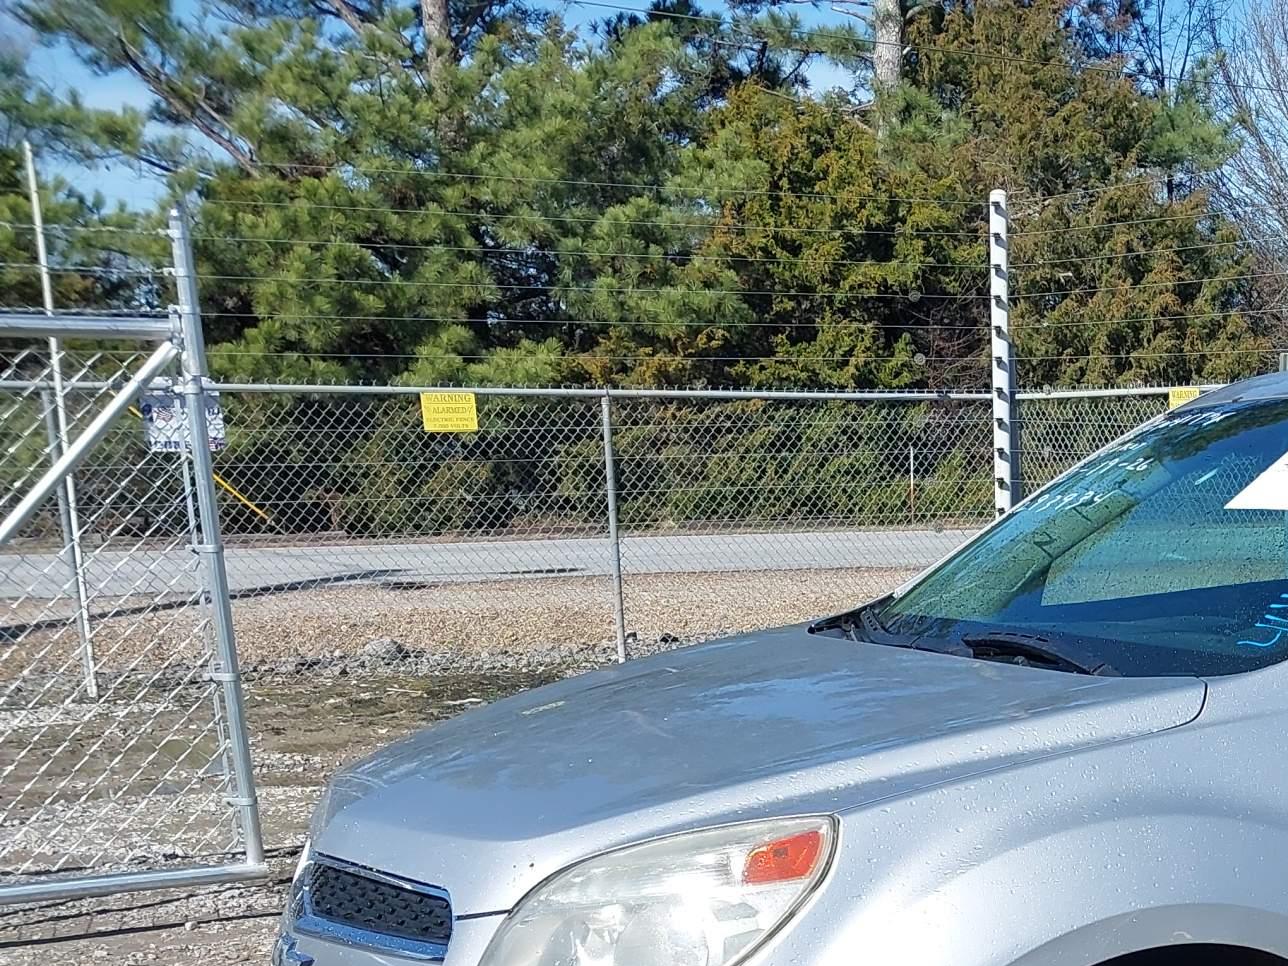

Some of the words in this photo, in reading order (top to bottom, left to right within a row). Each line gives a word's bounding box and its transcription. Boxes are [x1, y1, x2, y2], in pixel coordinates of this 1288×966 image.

[424, 394, 473, 403] WARNING
[1171, 390, 1198, 399] WARNING
[432, 406, 467, 414] ALARMED
